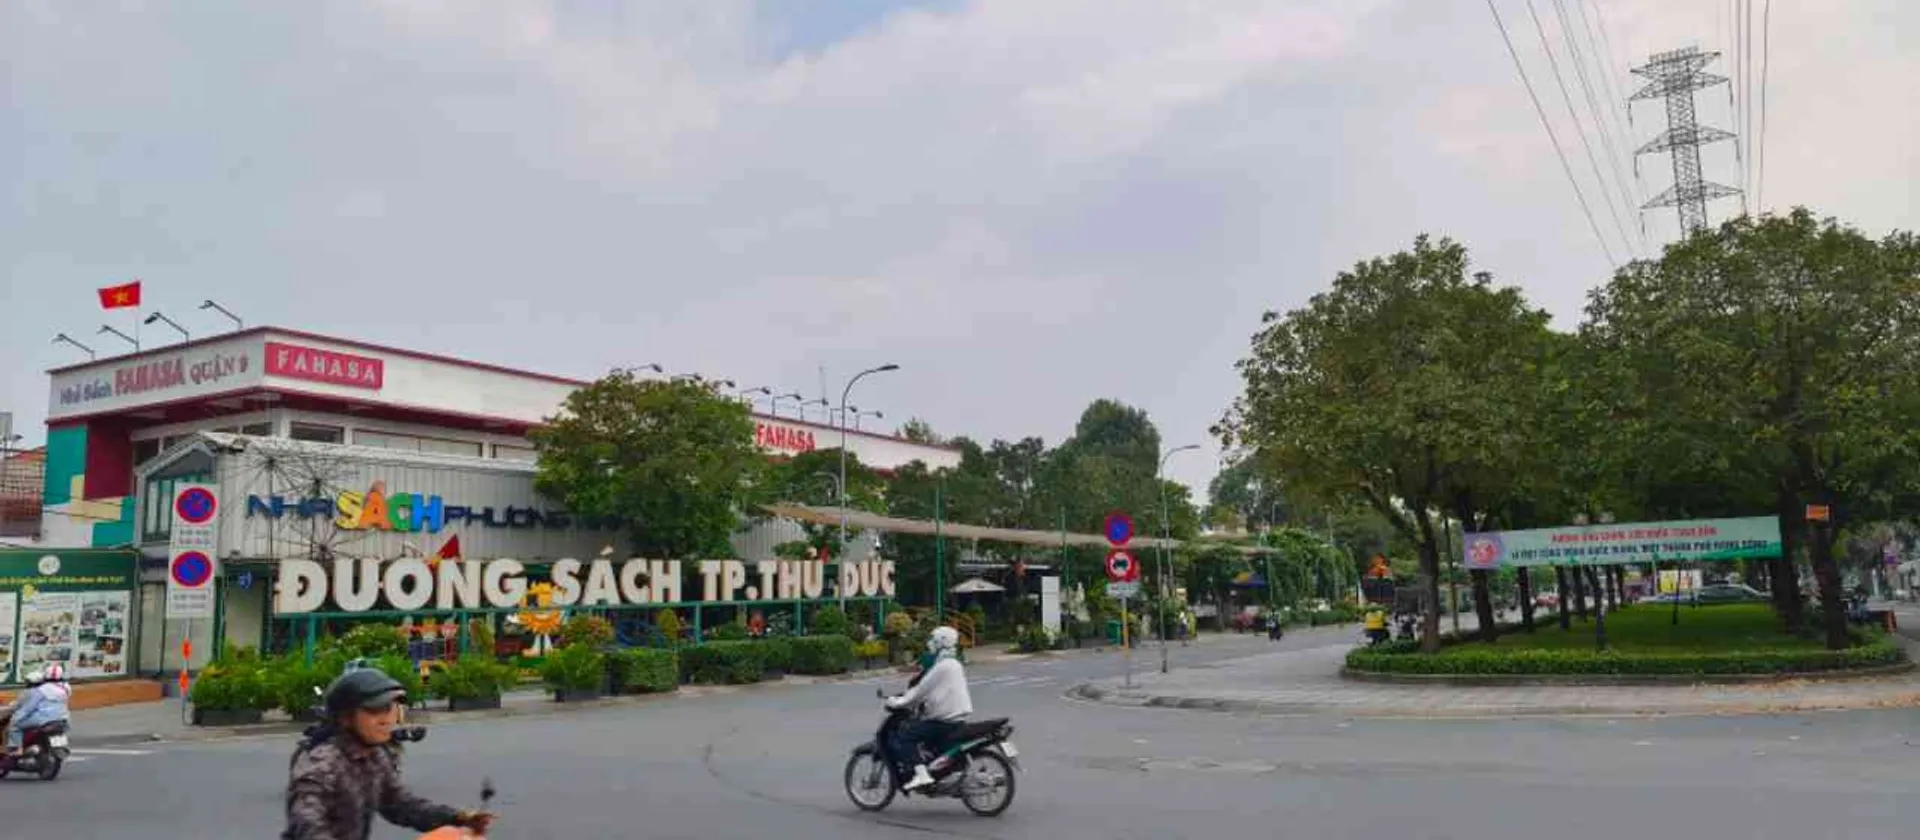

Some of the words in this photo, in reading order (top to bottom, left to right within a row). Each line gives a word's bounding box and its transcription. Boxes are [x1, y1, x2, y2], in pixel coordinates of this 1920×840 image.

[114, 357, 186, 396] FAHASA
[190, 353, 234, 385] QUẬN
[277, 348, 377, 384] FAHASA
[756, 423, 816, 453] FAHASA
[336, 480, 443, 533] SÁCH
[551, 545, 682, 606] SÁCH
